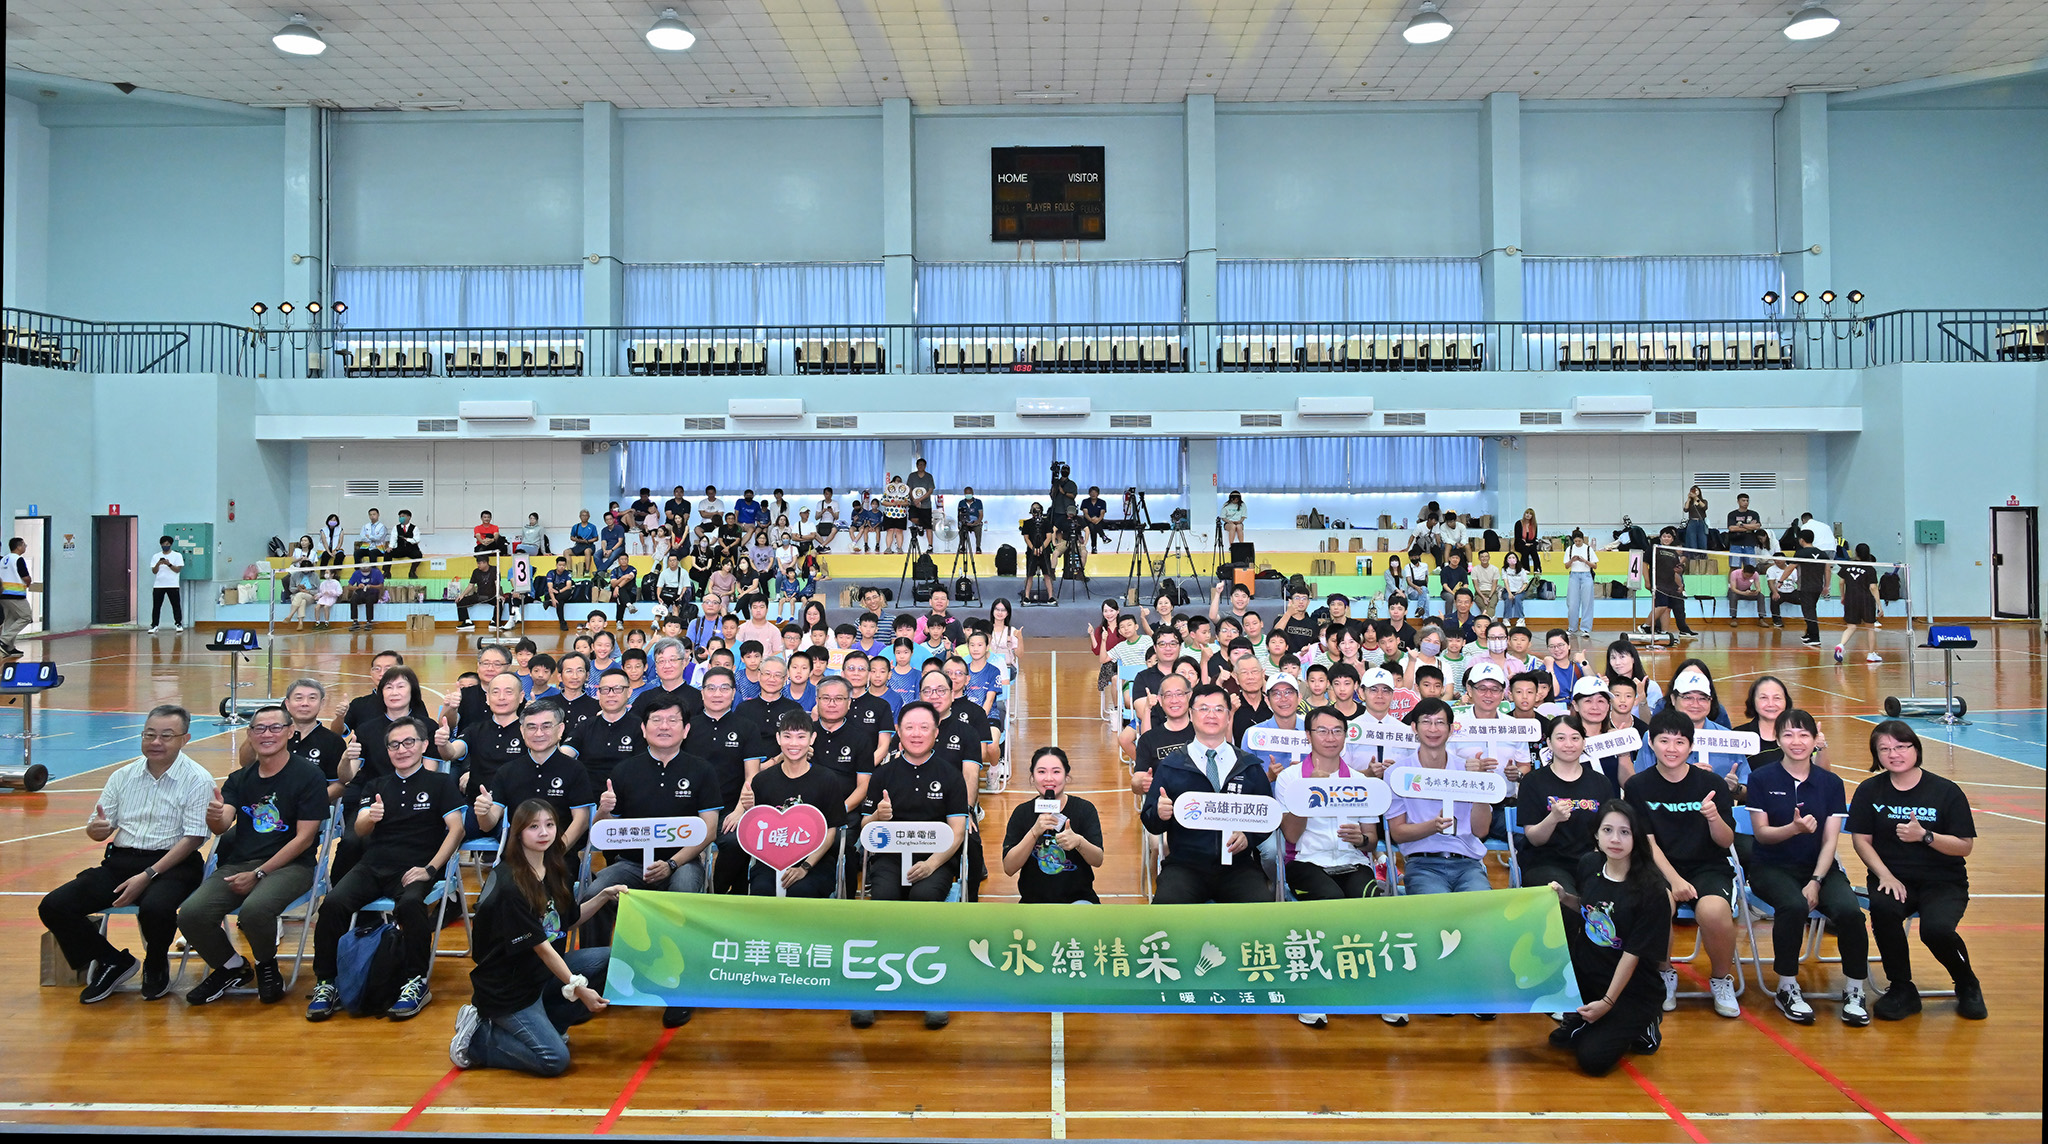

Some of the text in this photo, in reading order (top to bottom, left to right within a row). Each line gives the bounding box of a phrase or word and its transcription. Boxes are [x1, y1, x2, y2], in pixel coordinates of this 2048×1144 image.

[998, 174, 1028, 183] HOME
[1068, 173, 1099, 182] VISITOR
[1026, 202, 1075, 212] PLAYER FOULS
[517, 560, 527, 582] 3
[1630, 556, 1639, 578] 4
[216, 631, 225, 643] 0
[242, 631, 251, 644] 0
[4, 666, 14, 680] 0
[40, 665, 50, 680] 0
[1468, 725, 1537, 735] 高雄市獅湖國小
[1270, 735, 1311, 747] 高雄市中
[1424, 776, 1496, 791] 高雄市政府教育局
[1329, 786, 1368, 802] KSD
[1204, 800, 1269, 817] 高雄市政府
[1663, 802, 1703, 812] VICTO
[606, 823, 692, 843] 中華電信 ESG
[895, 830, 937, 839] 中華電信
[1000, 928, 1418, 984] 永續精采 與戴前行
[711, 938, 947, 992] 中華電信 ESG
[709, 968, 831, 987] Chunghwa Telecom
